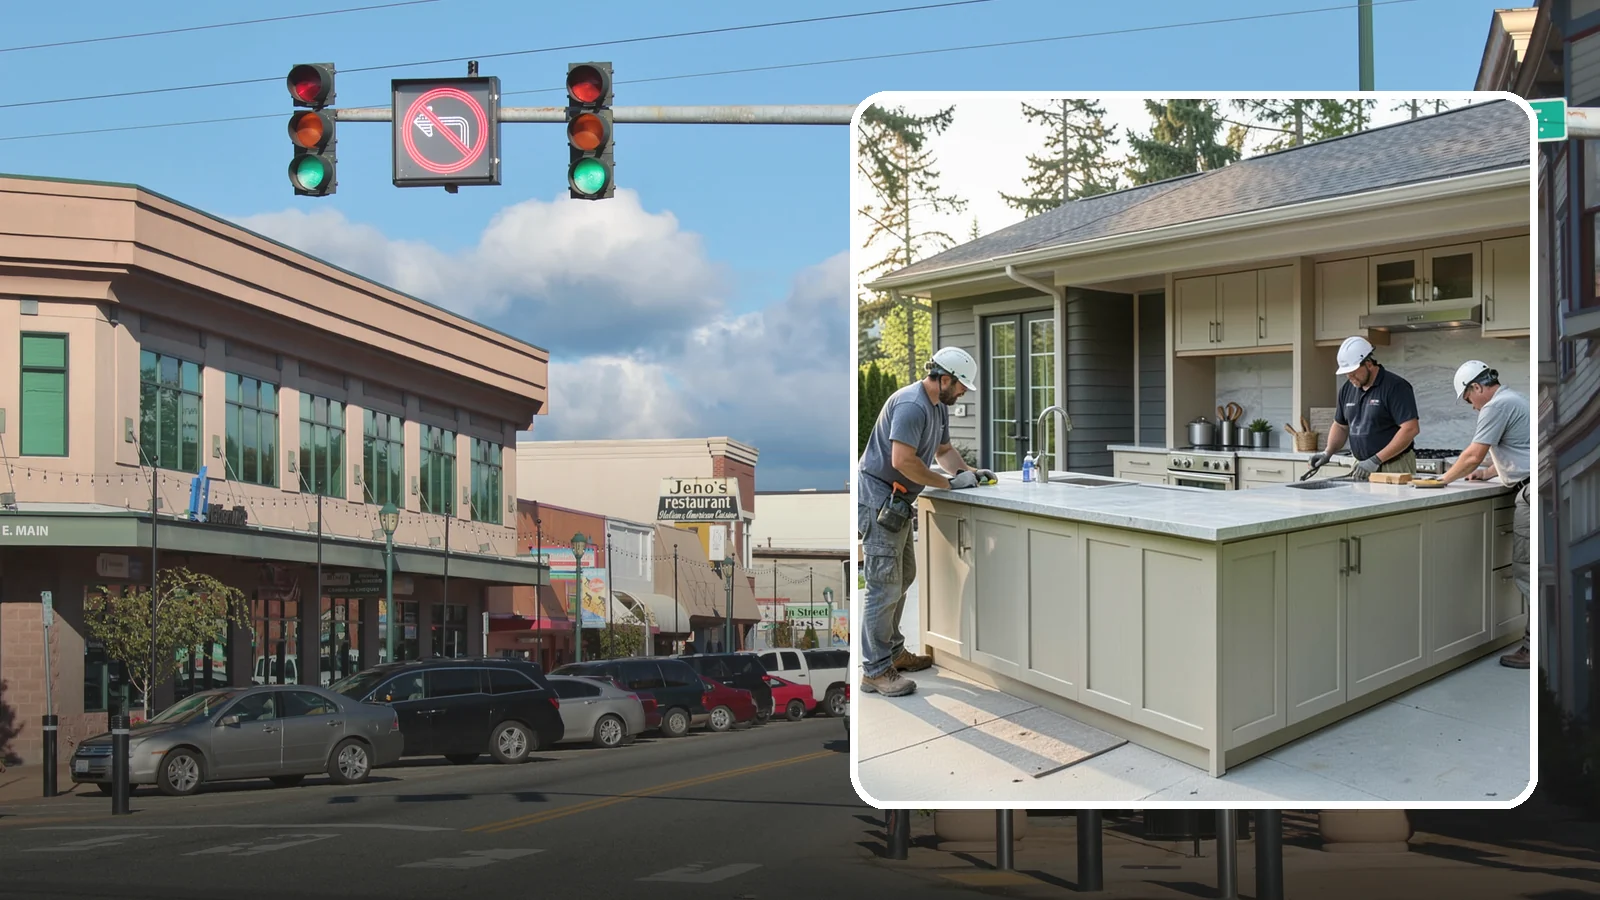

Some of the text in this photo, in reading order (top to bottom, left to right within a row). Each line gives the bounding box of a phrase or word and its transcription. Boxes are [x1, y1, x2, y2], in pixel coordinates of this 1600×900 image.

[669, 480, 728, 495] Jeno's
[665, 496, 731, 509] restaurant
[686, 510, 715, 519] American
[715, 509, 738, 519] Cuisine
[2, 525, 49, 536] E. MAIN
[797, 607, 829, 617] Street
